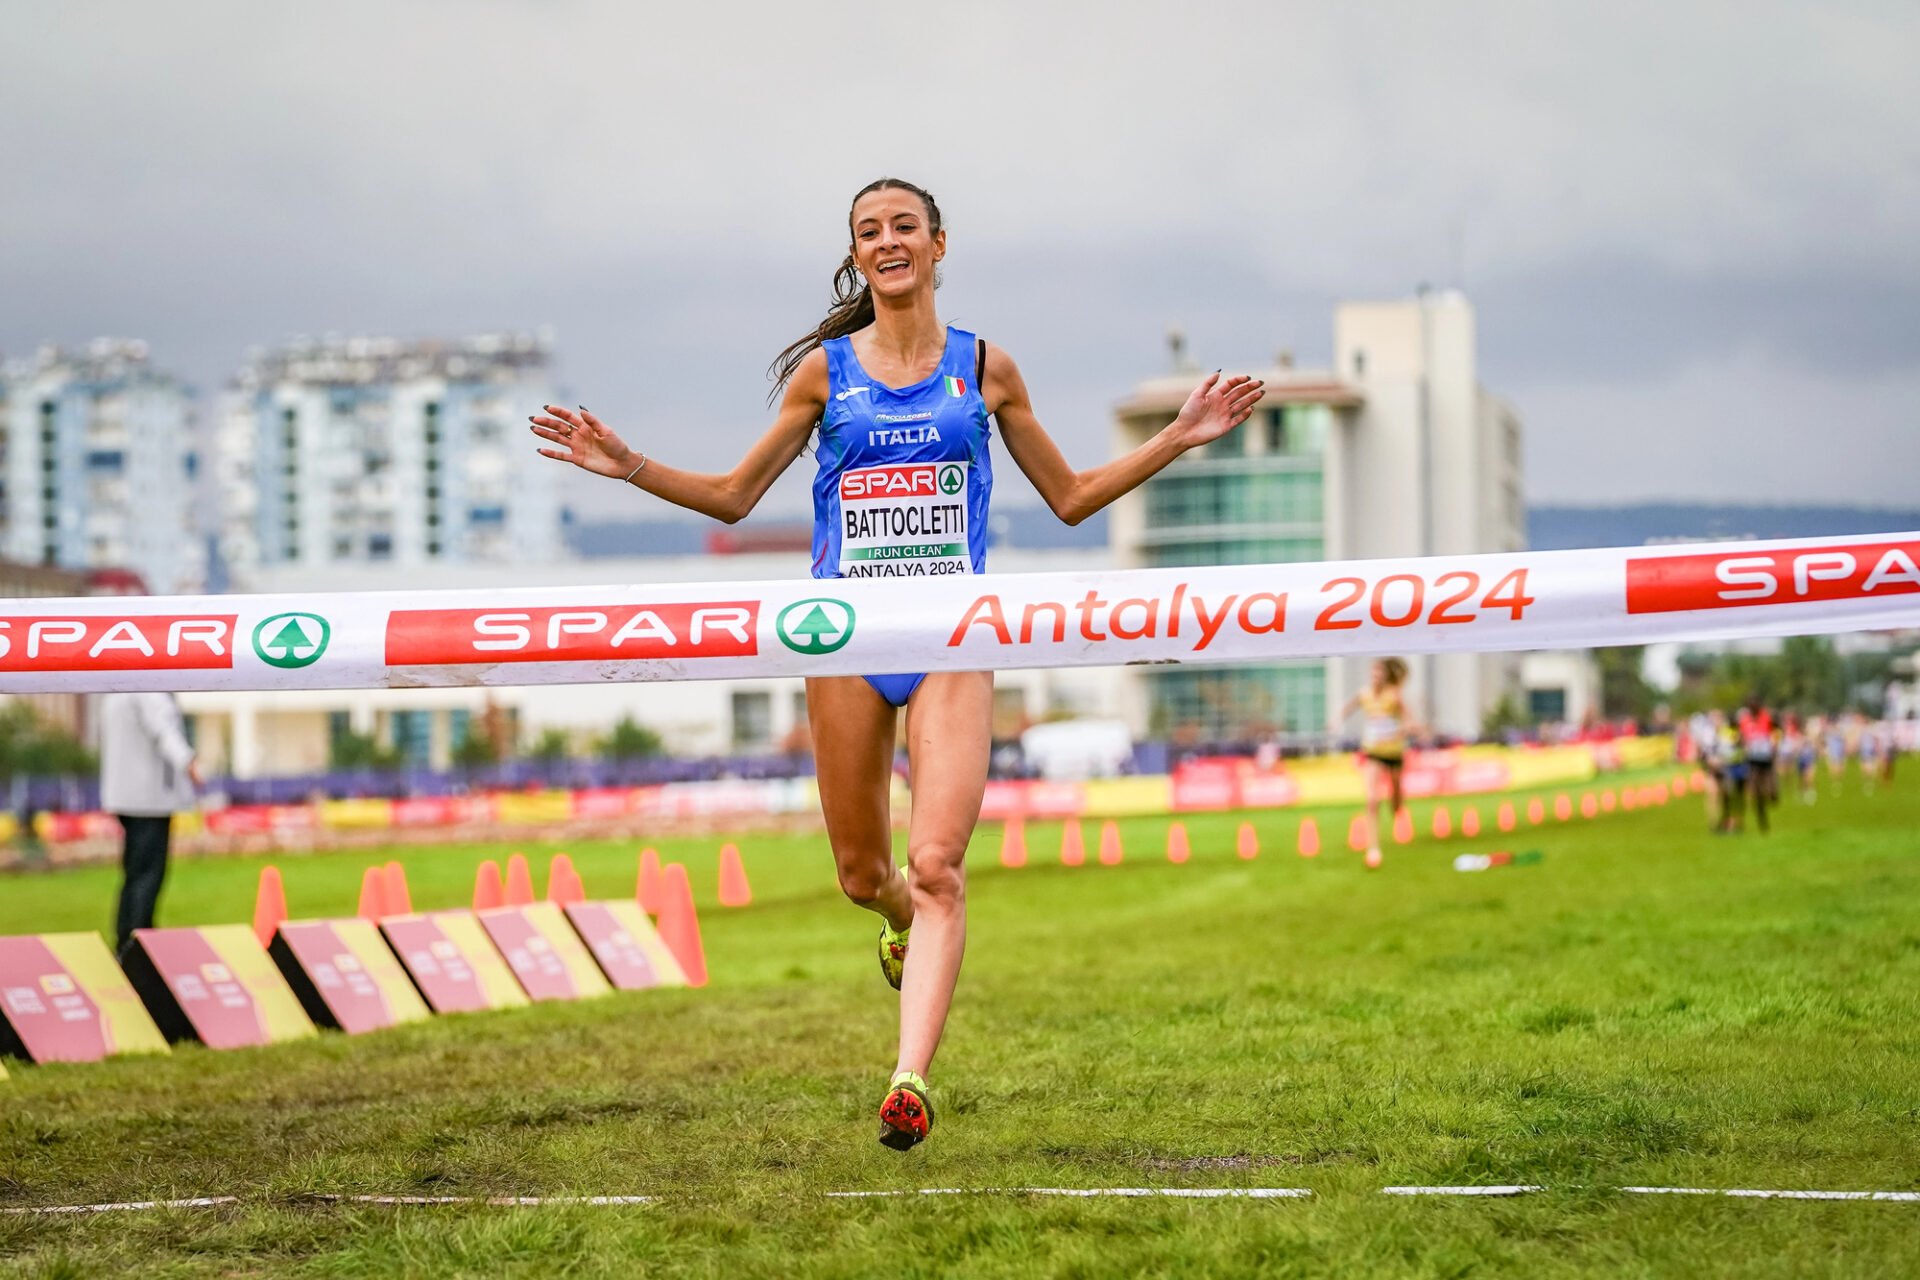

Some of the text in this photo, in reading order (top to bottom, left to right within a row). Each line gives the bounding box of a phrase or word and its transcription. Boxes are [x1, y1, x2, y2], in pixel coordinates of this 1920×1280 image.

[869, 427, 942, 446] ITALIA
[843, 469, 935, 495] SPAR
[846, 504, 964, 539] BATTOCLETTI
[868, 549, 872, 558] I
[874, 548, 901, 558] RUN
[850, 560, 965, 578] ANTALYA 2024
[946, 567, 1535, 651] Antalya 2024
[0, 620, 228, 658] PAR
[472, 607, 751, 650] SPAR
